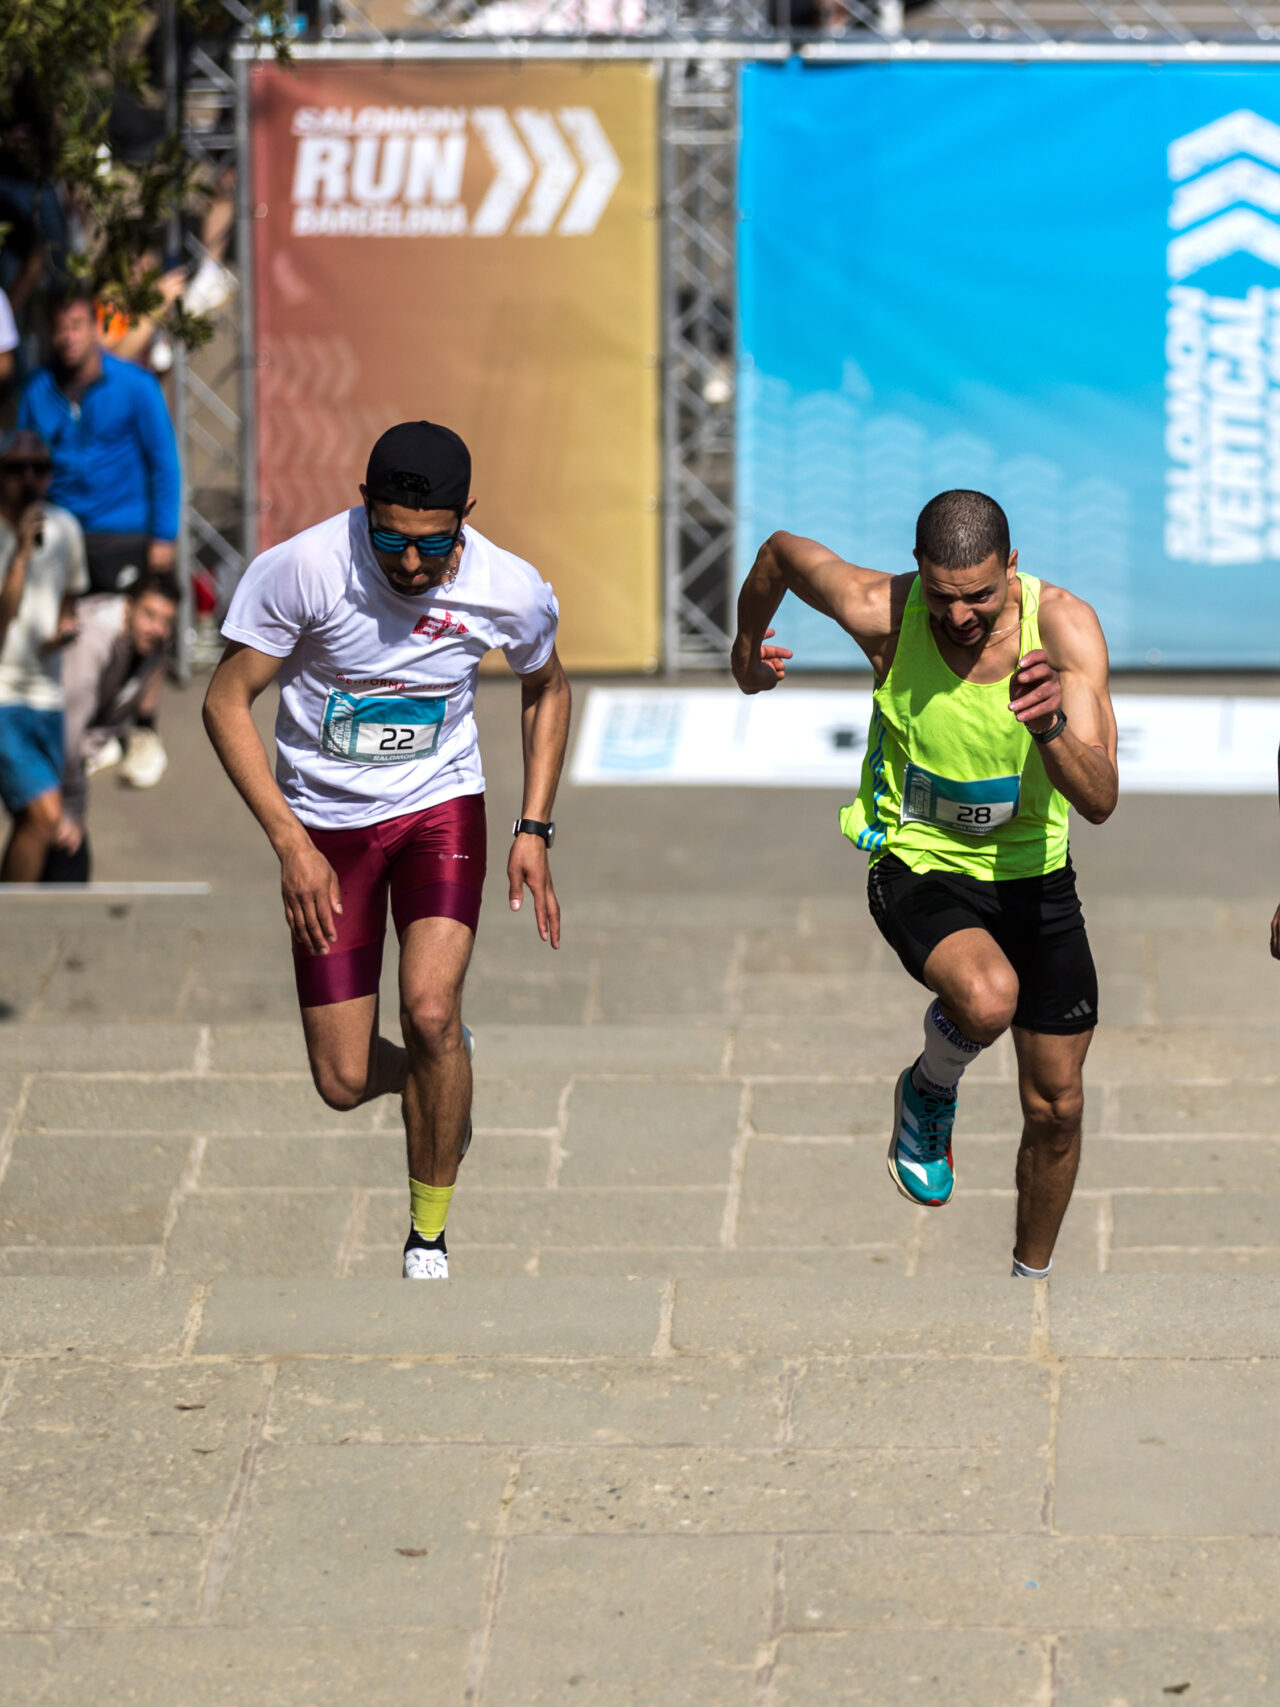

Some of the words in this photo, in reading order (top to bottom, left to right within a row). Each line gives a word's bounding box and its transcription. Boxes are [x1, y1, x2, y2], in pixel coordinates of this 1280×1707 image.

[292, 135, 467, 203] RUN
[1165, 285, 1206, 562] SALOMON
[1205, 285, 1268, 566] VERTICAL
[379, 728, 415, 750] 22
[957, 806, 991, 824] 28
